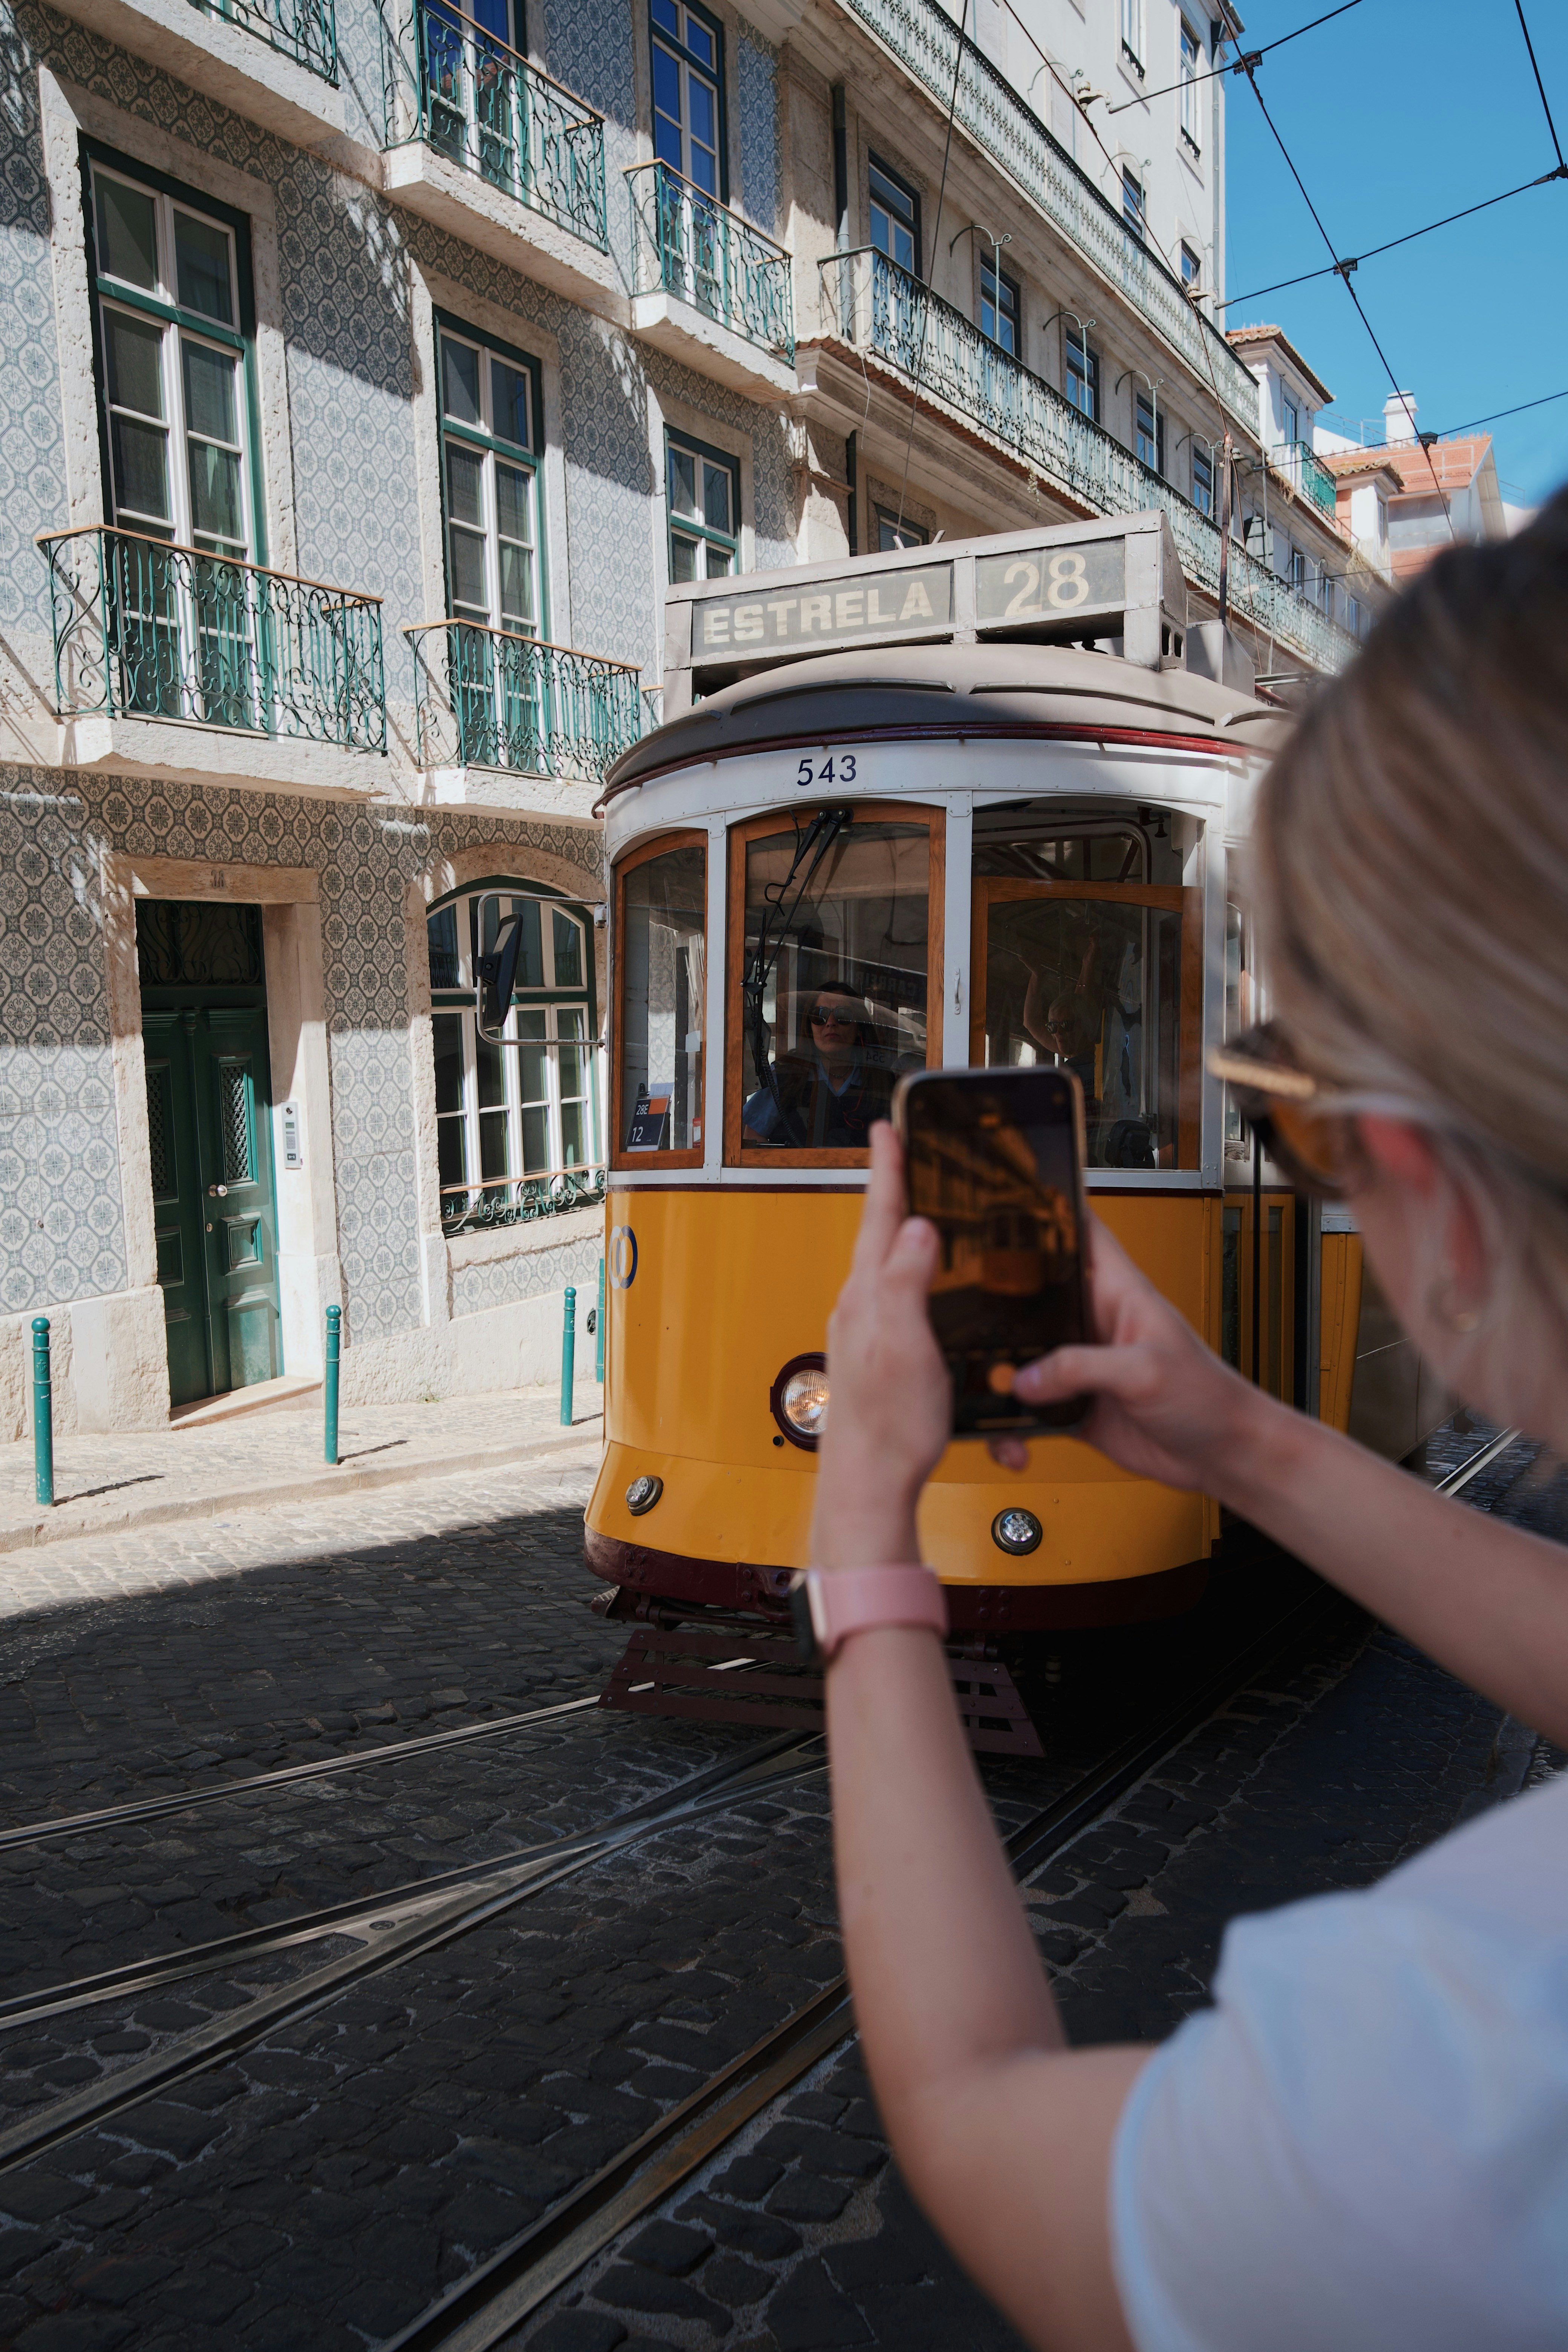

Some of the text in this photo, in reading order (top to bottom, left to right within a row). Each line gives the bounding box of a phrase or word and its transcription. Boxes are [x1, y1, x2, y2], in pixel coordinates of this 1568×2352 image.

[703, 552, 1089, 645] ESTRELA 28
[797, 755, 856, 786] 543
[211, 870, 225, 888] 38
[636, 1104, 649, 1115] 28E
[632, 1126, 643, 1142] 12
